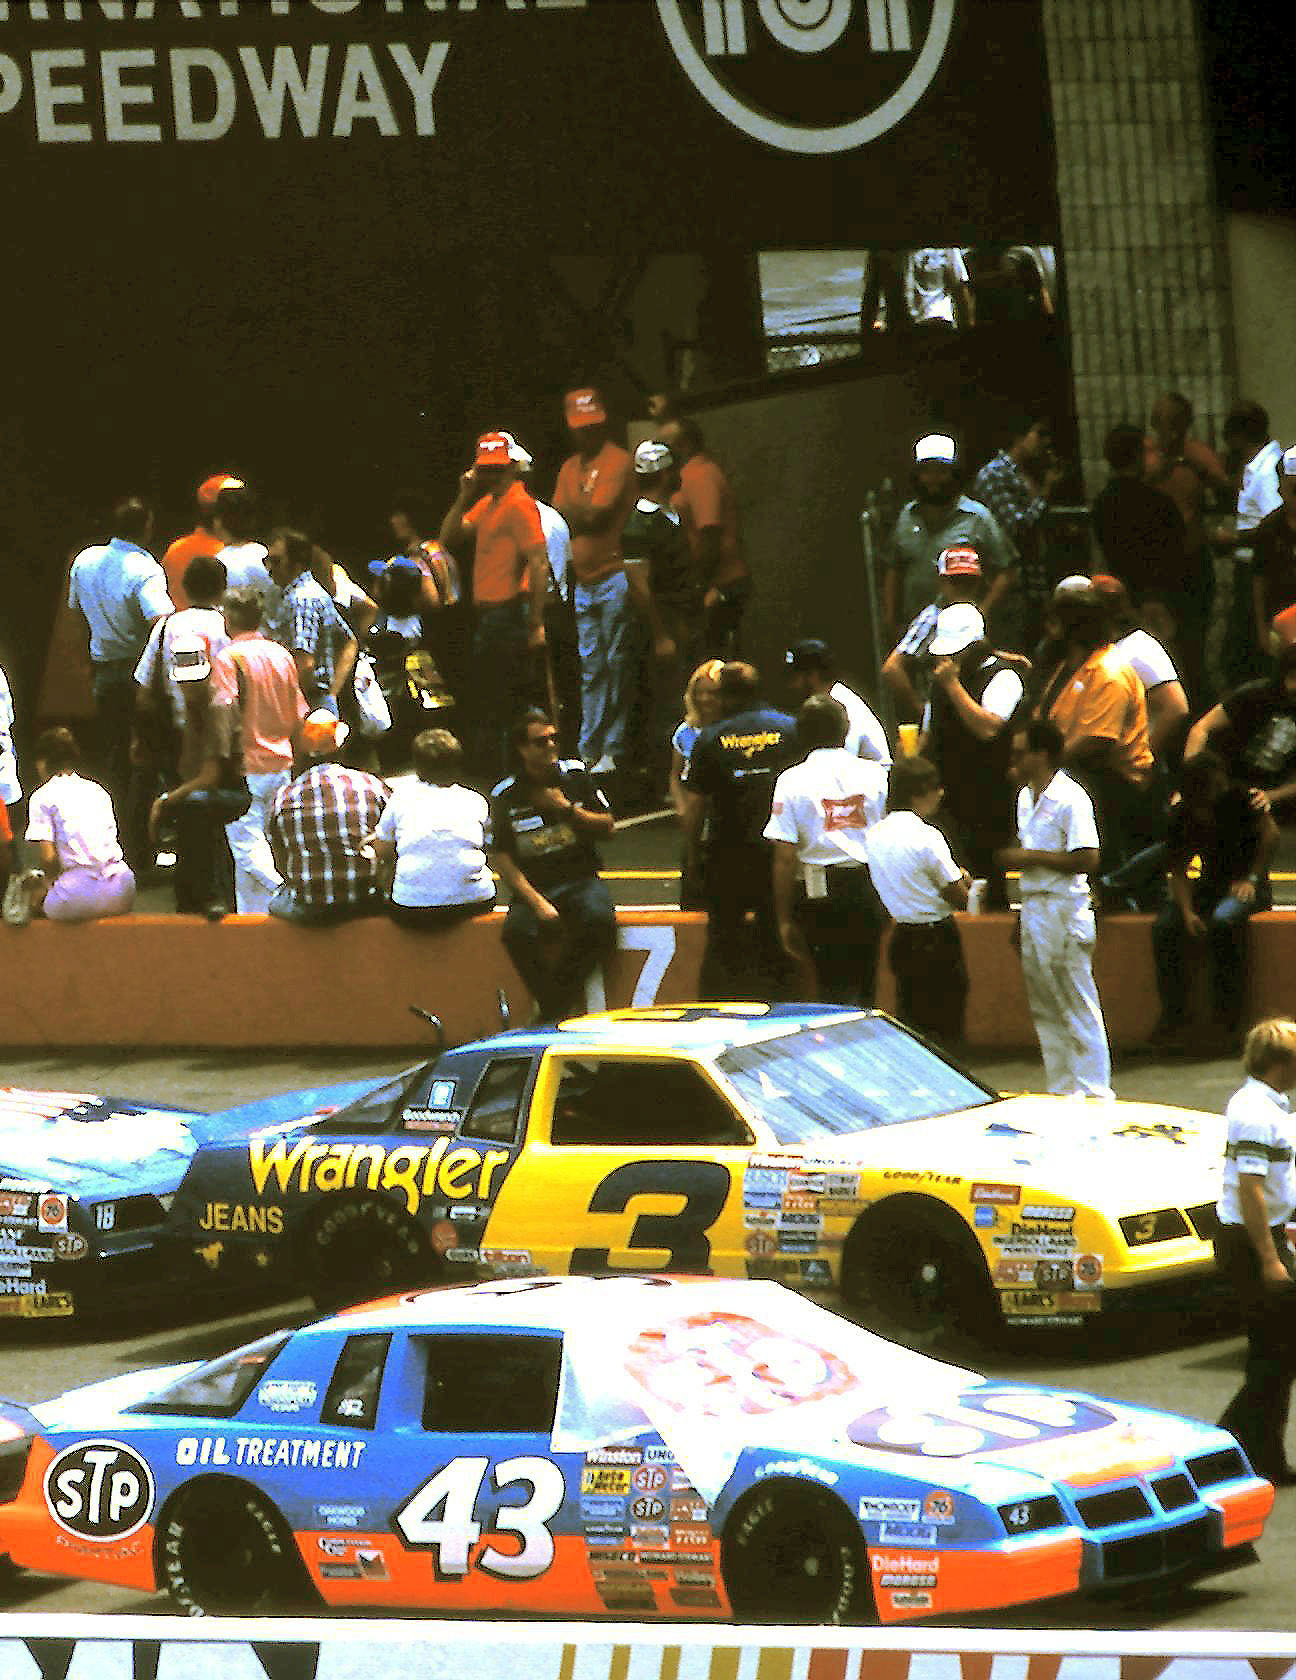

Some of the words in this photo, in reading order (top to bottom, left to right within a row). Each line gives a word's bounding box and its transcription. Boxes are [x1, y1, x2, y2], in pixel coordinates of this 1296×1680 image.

[248, 1135, 511, 1216] Wrangler
[198, 1201, 285, 1235] JEANS
[569, 1159, 733, 1275] 3
[57, 1235, 83, 1253] STP
[175, 1437, 231, 1466] OIL
[236, 1437, 367, 1469] TREATMENT
[55, 1449, 141, 1524] STP
[635, 1467, 664, 1489] STP
[396, 1454, 567, 1580] 43
[635, 1497, 663, 1517] STP
[871, 1556, 940, 1574] DieHard
